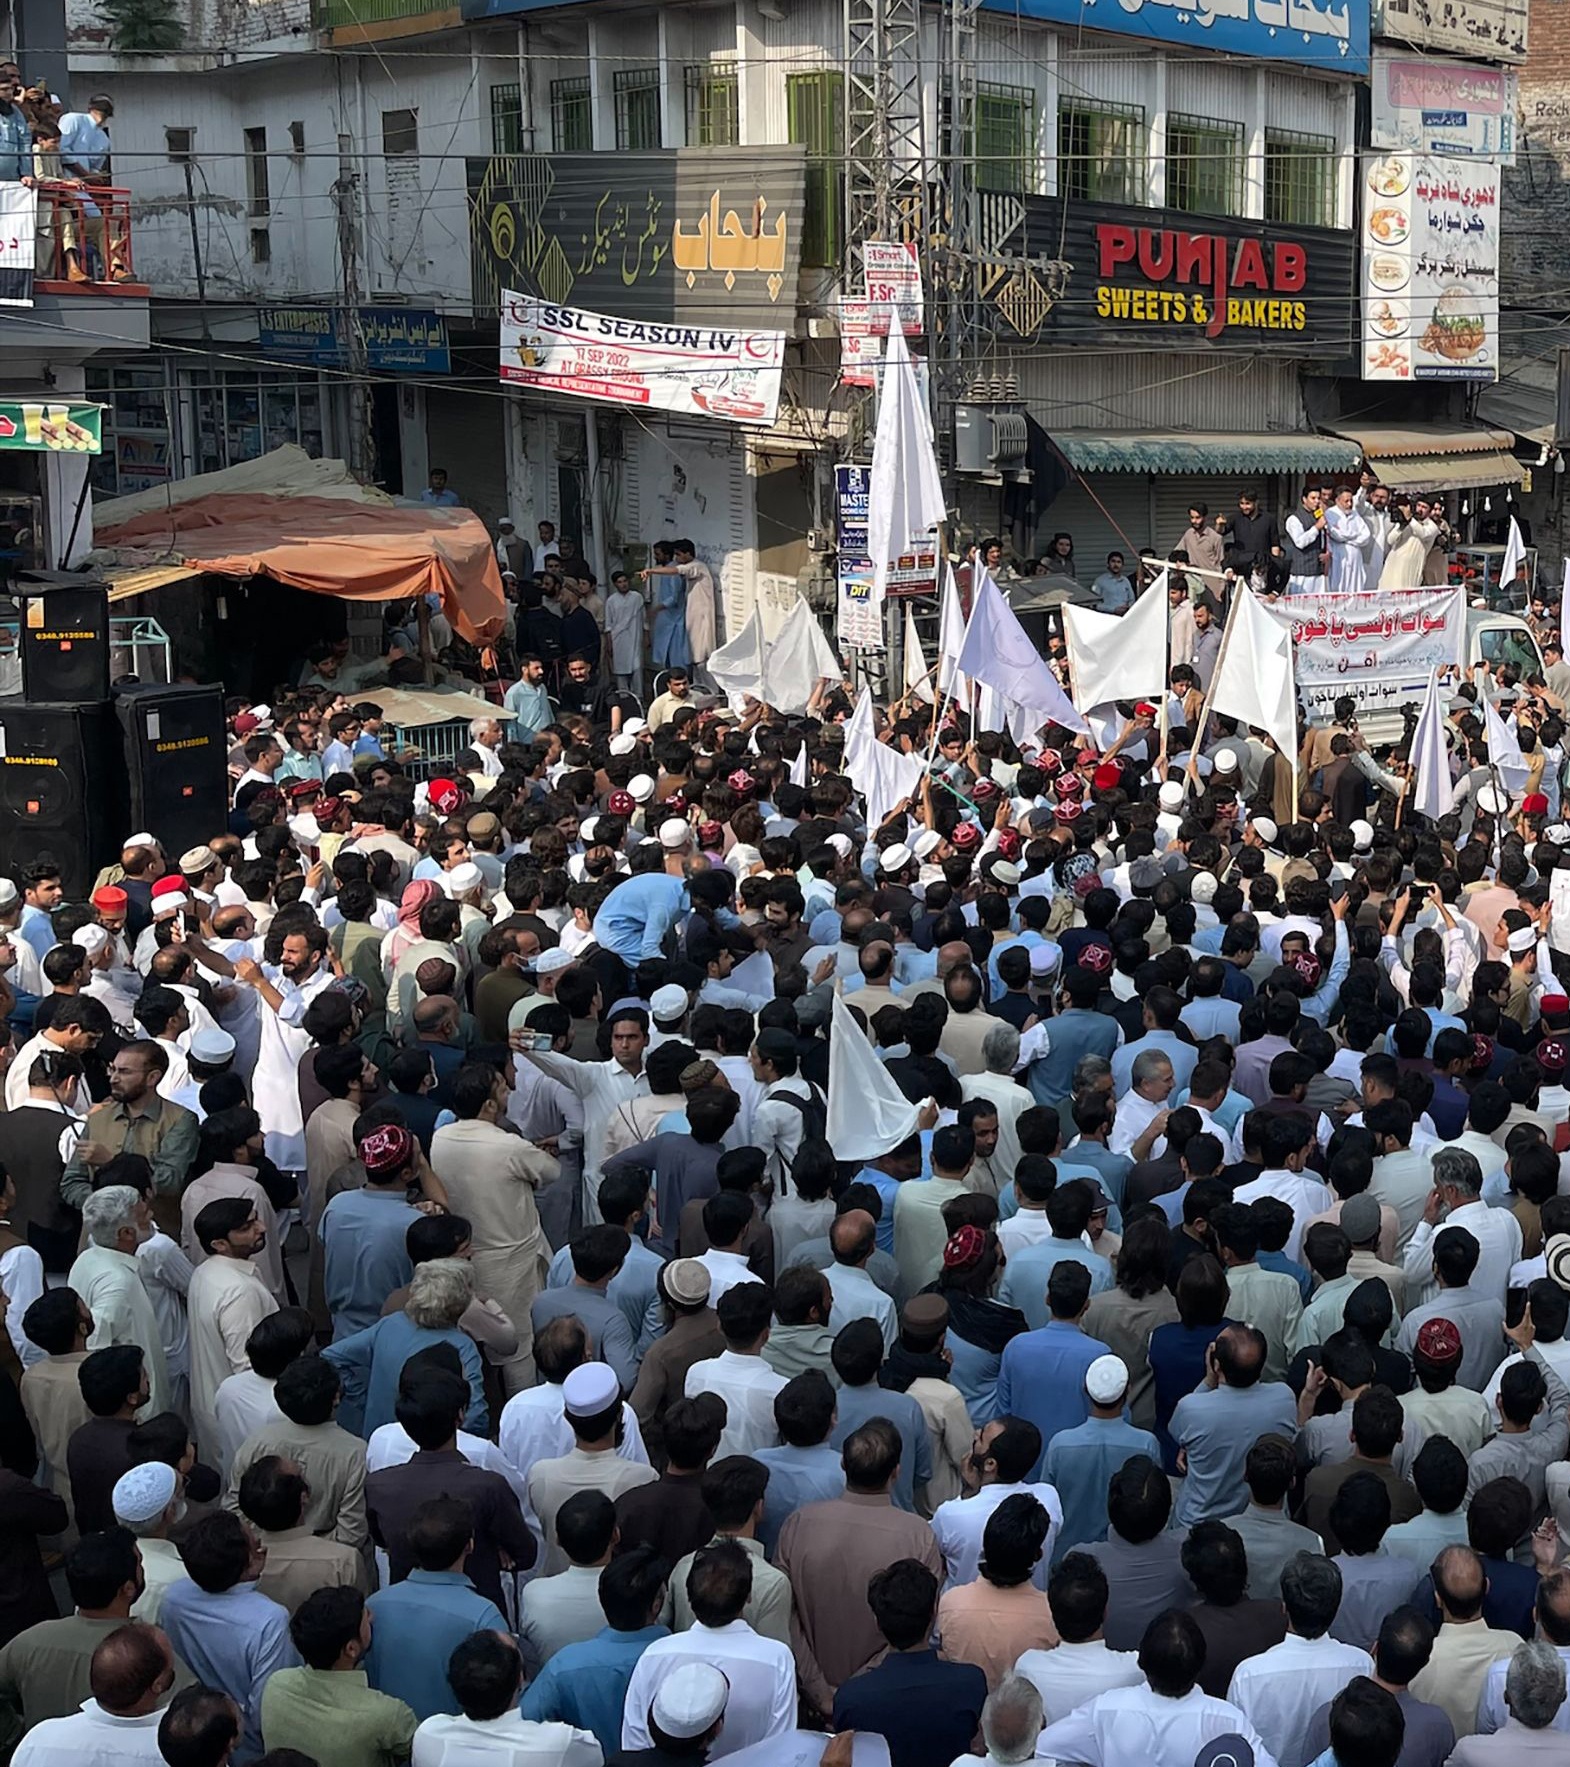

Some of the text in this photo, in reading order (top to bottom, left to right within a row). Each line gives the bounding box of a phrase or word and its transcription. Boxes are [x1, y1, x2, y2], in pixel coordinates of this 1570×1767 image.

[1536, 100, 1569, 117] Rock
[1428, 208, 1485, 240] چکن شوارما
[673, 189, 787, 302] پنجاب
[1097, 286, 1306, 330] SWEETS & BAKERS
[273, 310, 331, 334] ENTERPRISES
[543, 305, 736, 353] SSL SEASON IV
[560, 359, 573, 374] AT
[574, 361, 609, 379] GRASSY
[576, 348, 630, 368] 17 SEP 2022
[841, 494, 869, 507] MASTE
[850, 585, 868, 597] DIT
[1400, 607, 1446, 637] سوات
